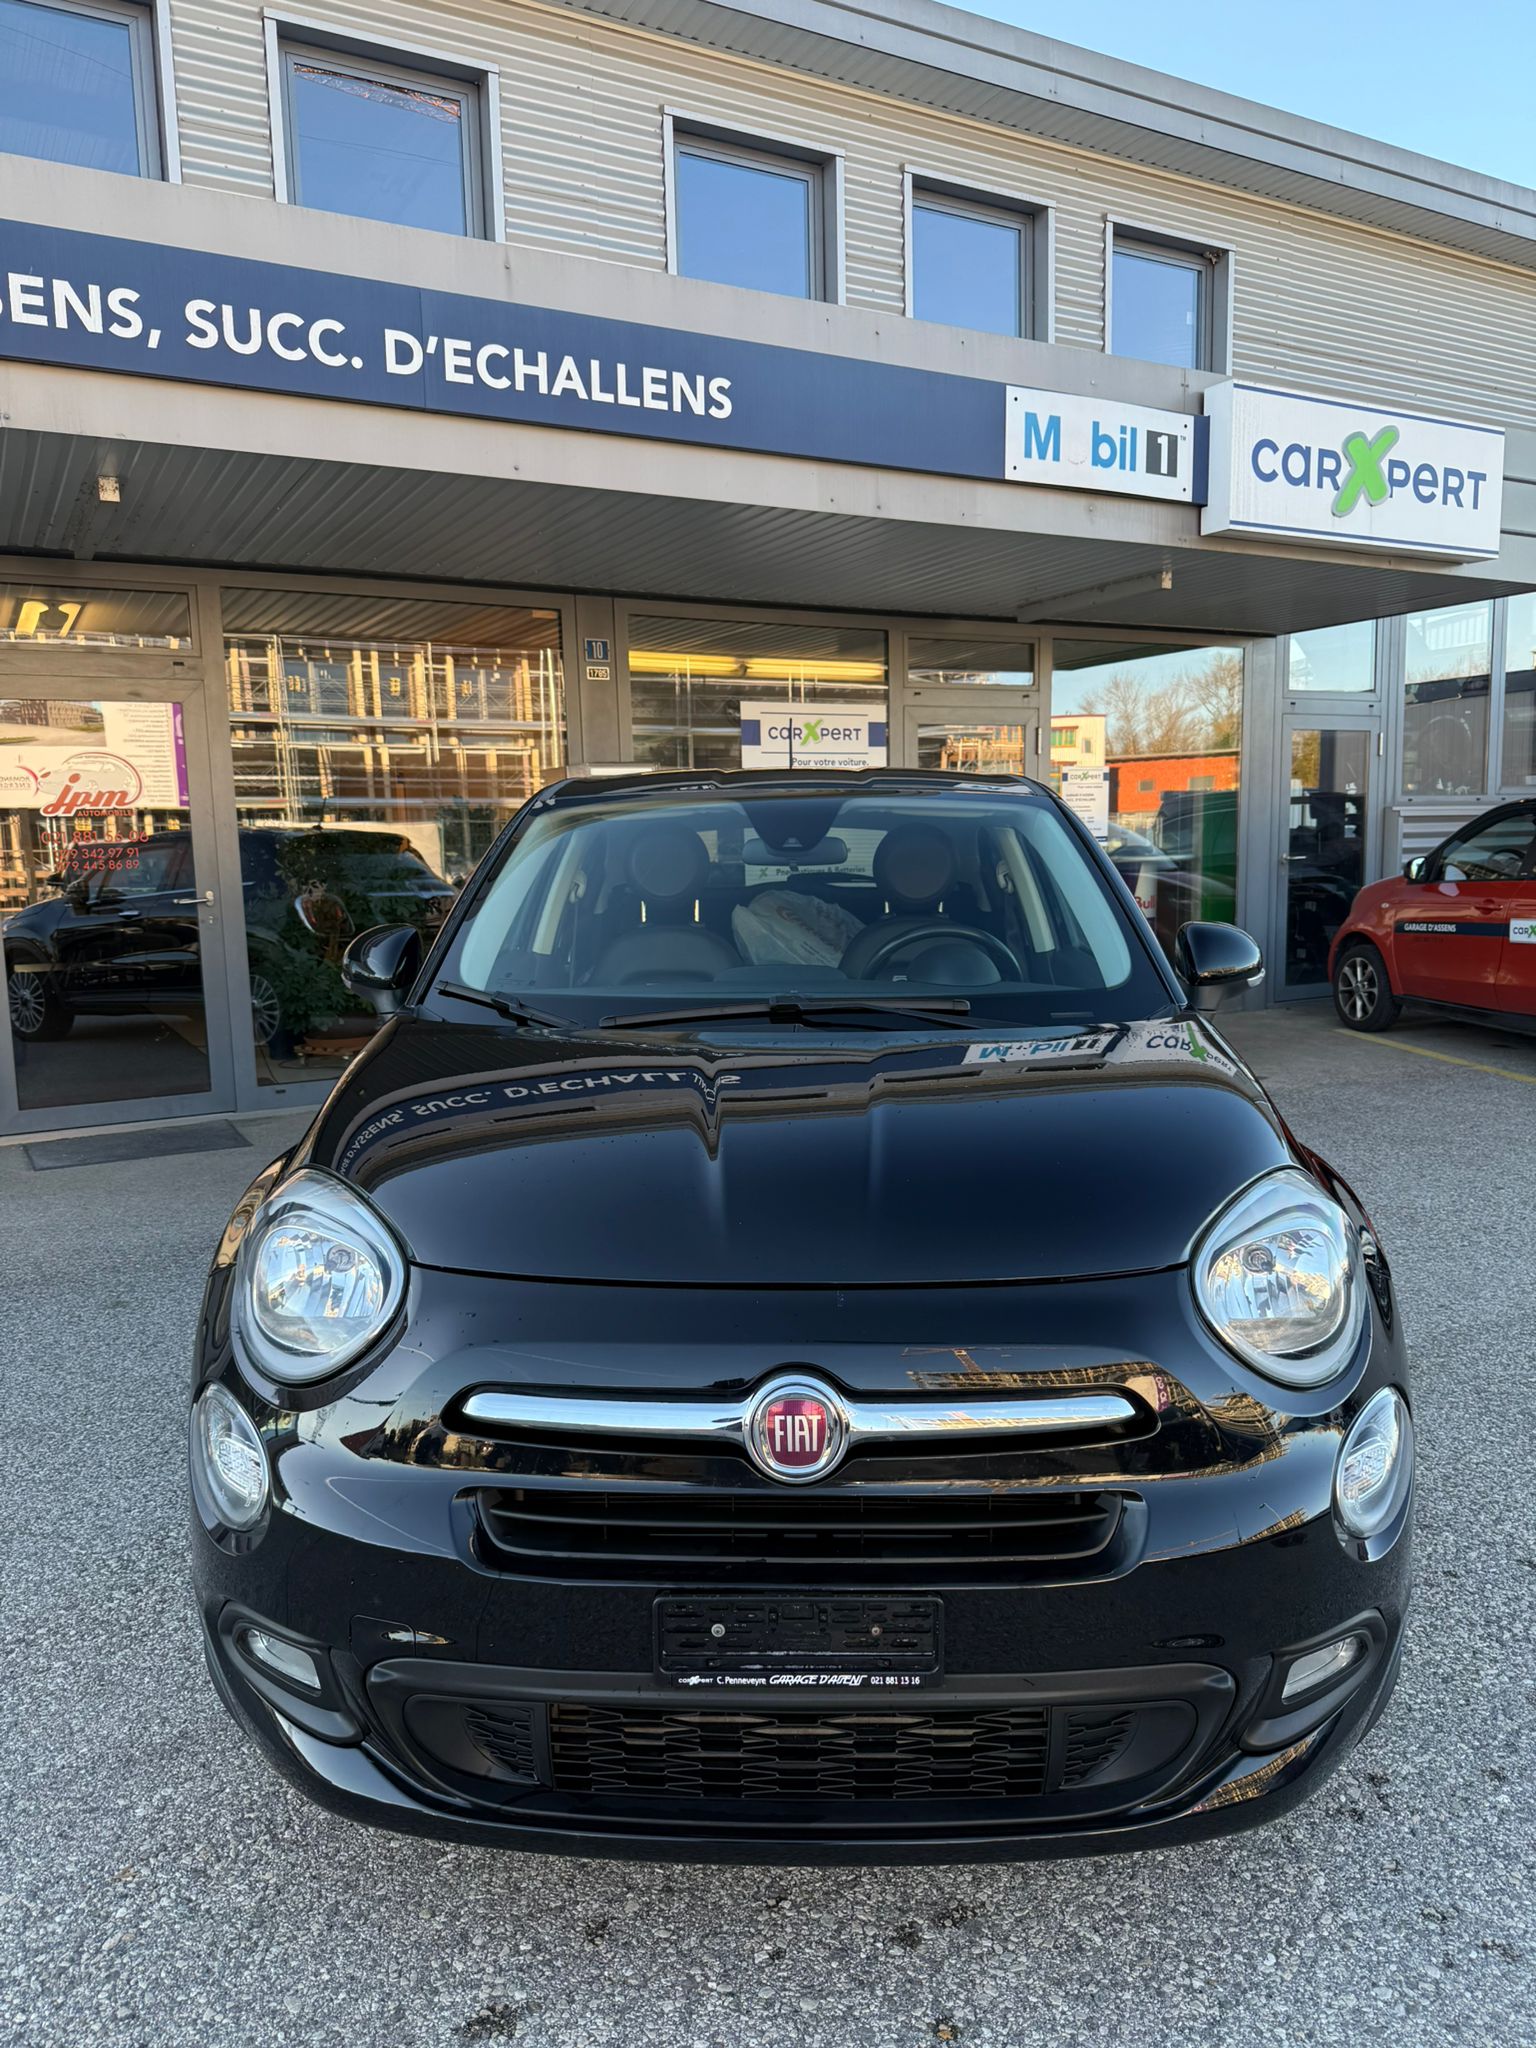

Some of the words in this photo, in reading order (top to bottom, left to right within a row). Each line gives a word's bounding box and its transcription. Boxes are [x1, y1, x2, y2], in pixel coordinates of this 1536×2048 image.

[0, 272, 161, 349] ENS,
[184, 299, 363, 369] SUCC.
[384, 328, 733, 419] D'ECHALLENS
[1023, 411, 1137, 472] Mbil
[592, 641, 604, 659] 10
[792, 758, 811, 766] Pour
[814, 758, 836, 766] votre
[838, 758, 869, 767] voiture.
[73, 831, 98, 843] 881
[128, 831, 149, 843] 06
[82, 848, 104, 859] 342
[108, 848, 123, 858] 97
[126, 848, 140, 858] 91
[83, 861, 105, 871] 445
[109, 861, 122, 870] 86
[126, 860, 139, 870] 89
[1404, 923, 1427, 931] GARAGE
[1428, 923, 1456, 932] D'ASSENS
[774, 1415, 821, 1452] FIAT
[769, 1675, 817, 1686] GARAGE
[870, 1676, 883, 1685] 021
[885, 1676, 898, 1685] 881
[911, 1676, 920, 1685] 16
